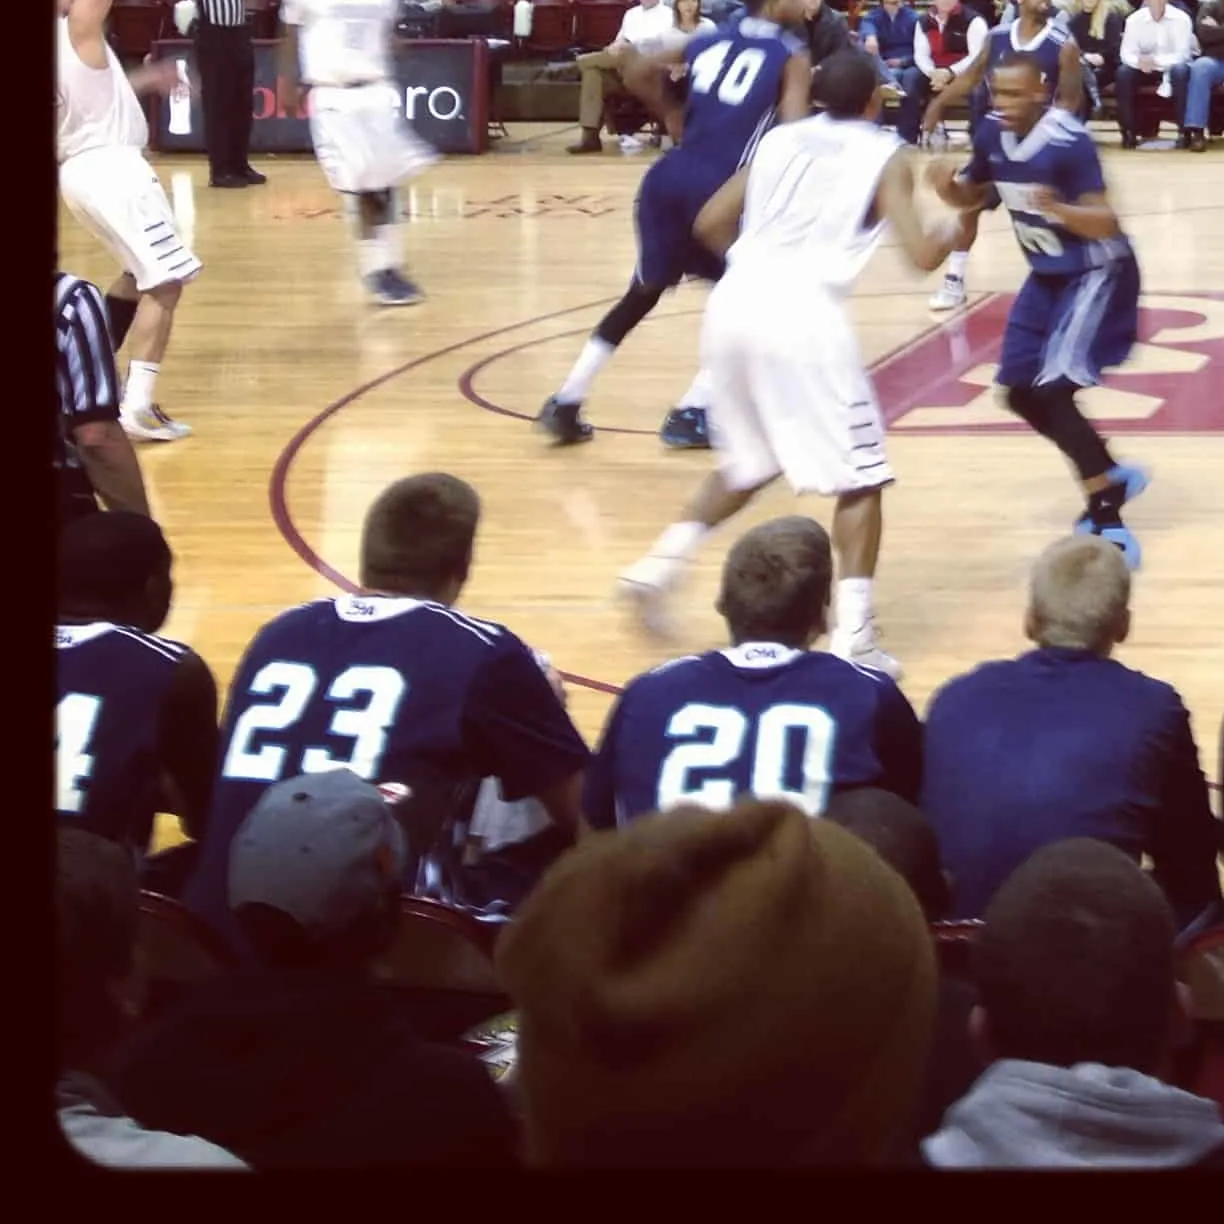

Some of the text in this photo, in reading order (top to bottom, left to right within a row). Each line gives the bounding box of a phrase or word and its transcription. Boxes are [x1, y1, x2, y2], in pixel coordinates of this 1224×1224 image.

[406, 86, 461, 120] ro
[692, 39, 768, 106] 40
[221, 658, 406, 781] 23
[657, 702, 836, 817] 20
